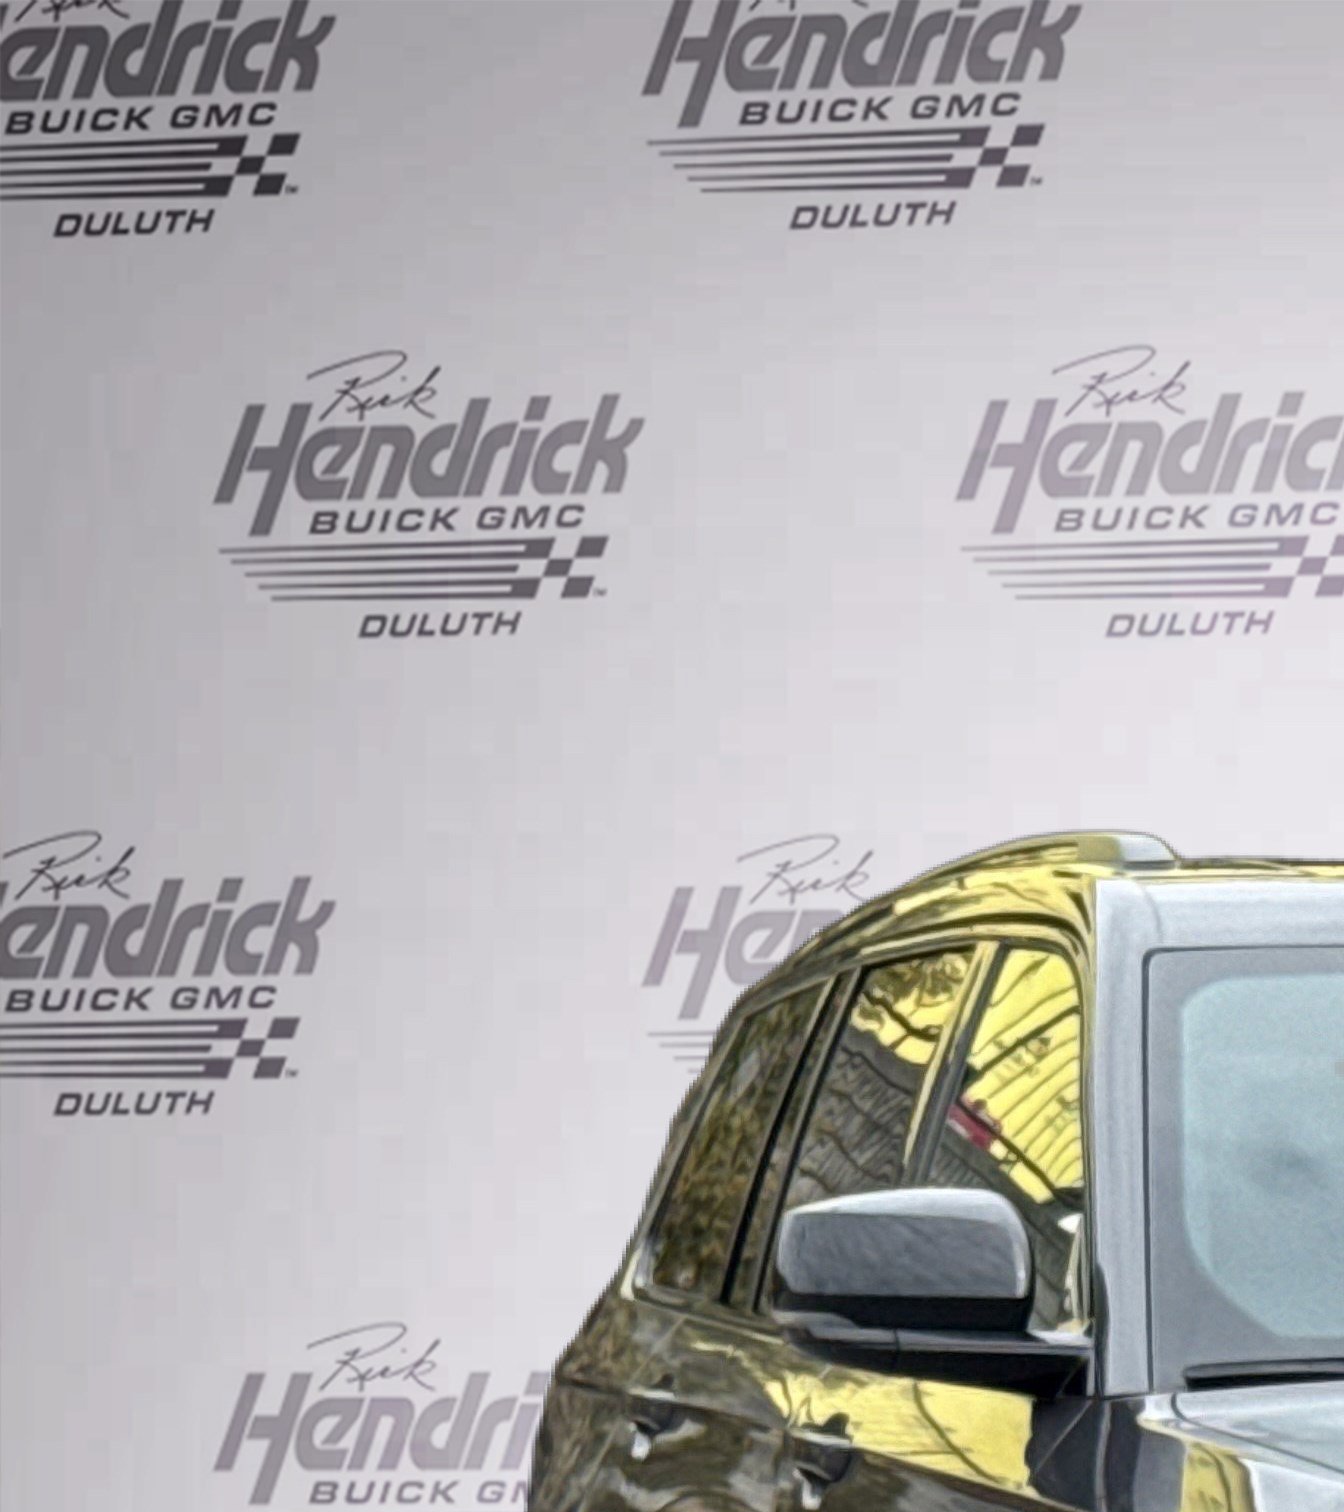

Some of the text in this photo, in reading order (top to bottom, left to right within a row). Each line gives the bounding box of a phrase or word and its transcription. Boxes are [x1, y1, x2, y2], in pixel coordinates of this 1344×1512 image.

[0, 0, 336, 101] endrick
[641, 0, 1083, 128] Hendrick
[4, 102, 277, 135] BUICK GMC
[738, 92, 1022, 126] BUICK GMC
[53, 209, 215, 238] DULUTH
[789, 202, 957, 230] DULUTH
[213, 394, 645, 537] Hendrick
[308, 503, 585, 535] BUICK GMC
[1053, 502, 1340, 532] BUICK GMC
[358, 611, 522, 638] DULUTH
[1105, 610, 1274, 638] DULUTH
[0, 876, 336, 979] endrick
[4, 986, 277, 1012] BUICK GMC
[53, 1091, 215, 1116] DULUTH
[213, 1371, 553, 1505] Hendri
[308, 1481, 458, 1504] BUICK
